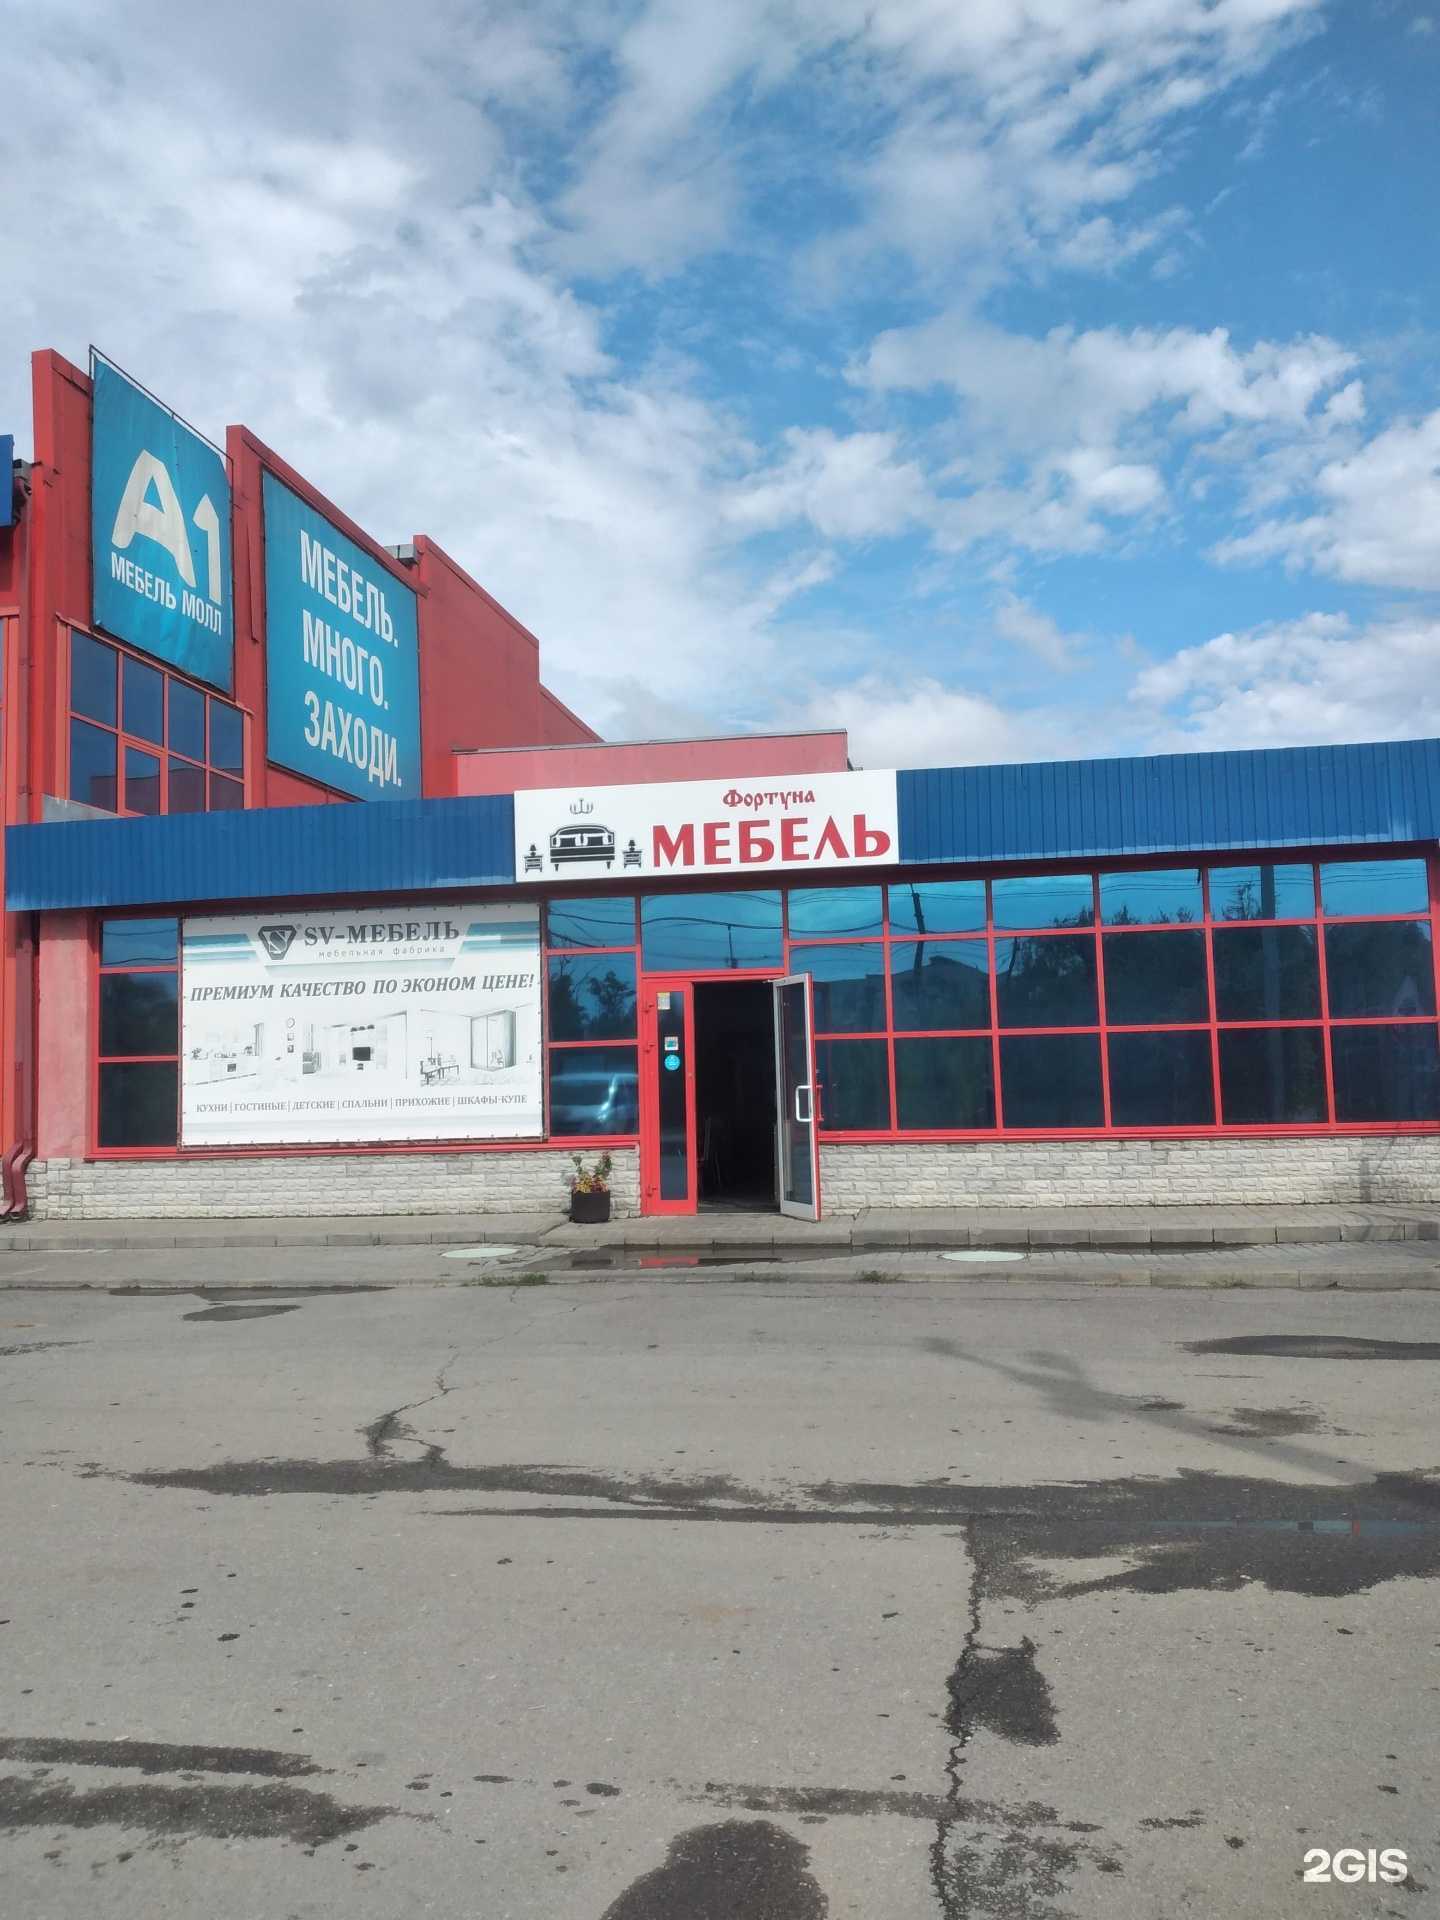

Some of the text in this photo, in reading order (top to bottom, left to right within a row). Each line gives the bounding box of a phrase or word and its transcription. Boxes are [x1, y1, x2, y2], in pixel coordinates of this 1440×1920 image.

[111, 551, 222, 635] МЕБЕЛЬ МОЛЛ
[300, 528, 399, 648] МЕБЕЛЬ.
[302, 608, 389, 710] МНОГО.
[303, 690, 402, 787] ЗАХОДИ.
[723, 789, 815, 811] Фортуна
[653, 814, 891, 868] МЕБЕЛЬ
[304, 921, 459, 946] SV-МЕБЕЛЬ
[318, 945, 445, 959] мебельная фабрика
[190, 973, 534, 1002] ПРЕМИУМ КАЧЕСТВО ПО ЭКОНОМ ЦЕНЕ!
[196, 1103, 228, 1113] КУХНИ
[234, 1101, 286, 1112] ГОСТИНЫЕ
[292, 1100, 335, 1111] ДЕТСКИЕ
[341, 1097, 388, 1109] СПАЛЬНИ
[395, 1096, 451, 1108] ПРИХОЖИЕ
